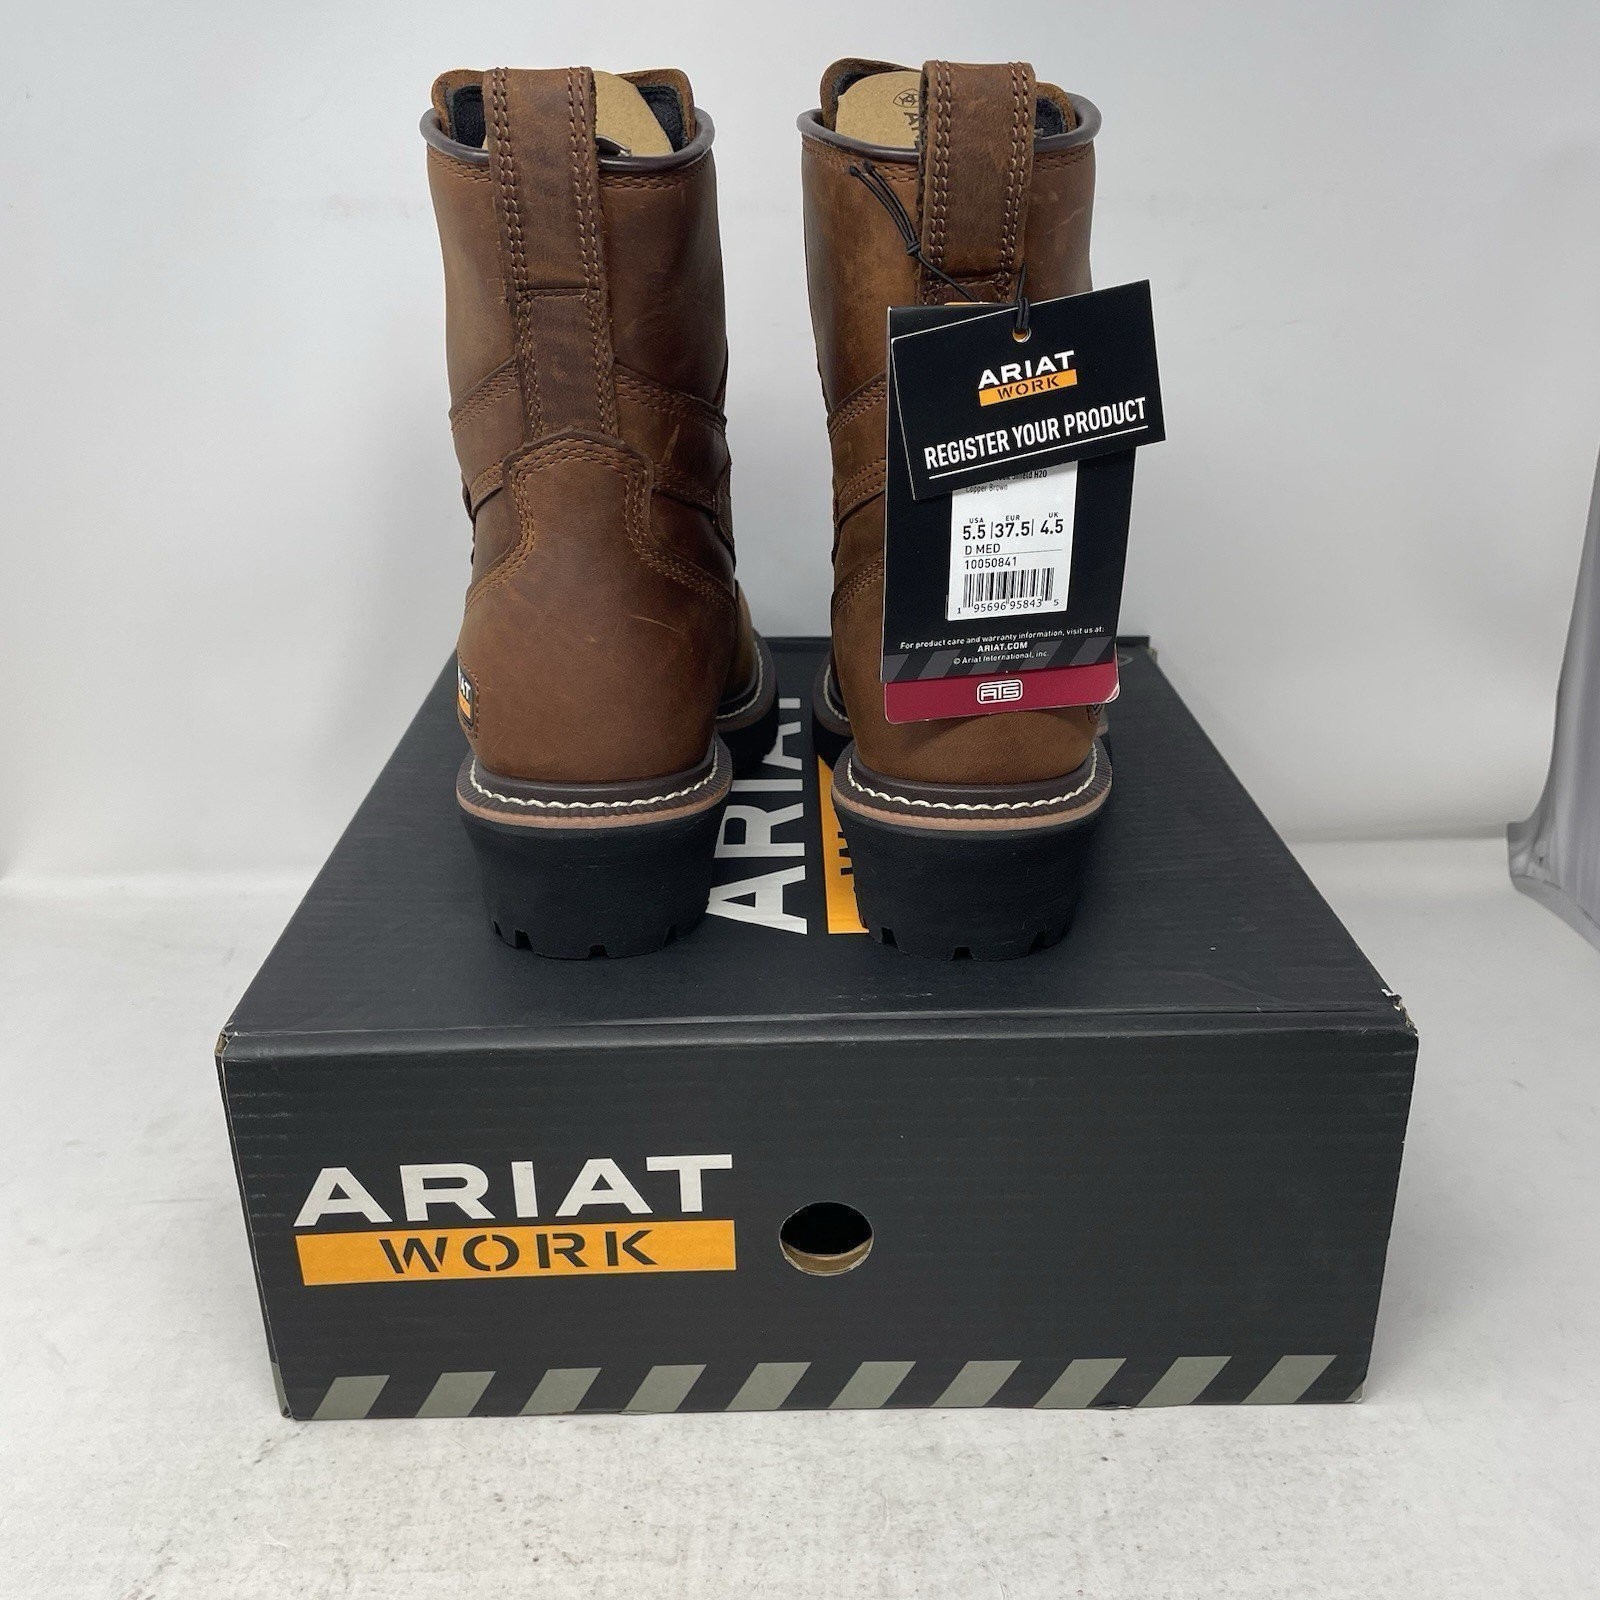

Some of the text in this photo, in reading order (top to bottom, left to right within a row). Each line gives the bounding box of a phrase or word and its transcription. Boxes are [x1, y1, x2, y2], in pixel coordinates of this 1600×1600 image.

[978, 350, 1075, 390] ARIAT
[997, 375, 1060, 400] WORK
[924, 397, 1146, 470] REGISTER YOUR PRODUCT
[965, 483, 1008, 494] Copper Brown
[963, 519, 1064, 540] 5.5 37.5 4.5
[965, 543, 1001, 555] D MED
[965, 556, 1017, 570] 10050841
[973, 601, 1007, 613] 95696
[1009, 598, 1042, 610] 95843
[900, 642, 914, 650] For
[915, 639, 946, 650] product
[947, 638, 965, 647] care
[966, 635, 981, 644] and
[982, 632, 1017, 642] warranty
[1018, 630, 1065, 640] information,
[1066, 627, 1082, 635] visit
[977, 641, 1028, 653] ARIAT.COM
[962, 655, 982, 664] Ariat
[983, 651, 1034, 662] International,
[705, 697, 808, 935] ARIA
[293, 1154, 733, 1228] ARIAT
[379, 1229, 660, 1275] WORK
